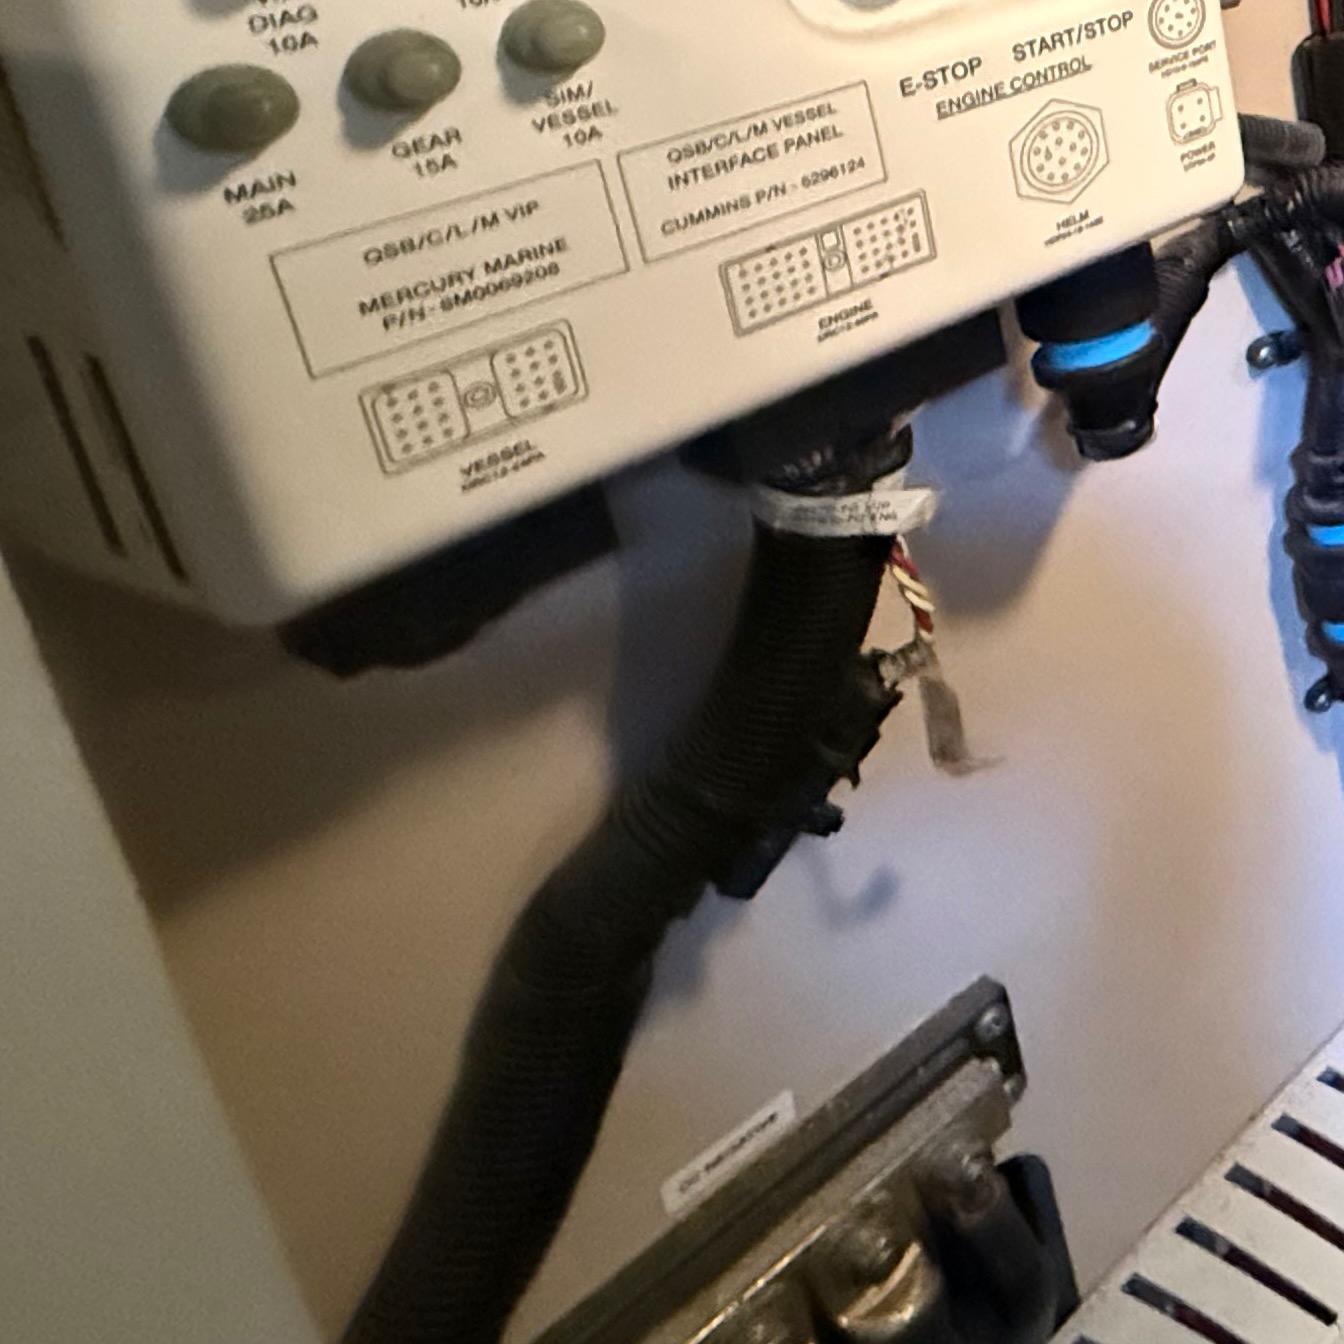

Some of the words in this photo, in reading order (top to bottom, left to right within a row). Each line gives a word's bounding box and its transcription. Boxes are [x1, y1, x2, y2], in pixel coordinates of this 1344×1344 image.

[248, 5, 318, 34] DIAG
[269, 31, 319, 56] 10A
[899, 56, 983, 98] E-STOP
[1012, 10, 1134, 62] START/STOP
[544, 80, 593, 107] SIM/
[935, 81, 1005, 118] ENGINE
[1009, 55, 1092, 95] CONTROL
[532, 100, 618, 134] VESSEL
[773, 102, 838, 132] VESSEL
[391, 126, 462, 158] GEAR
[563, 125, 603, 148] 10A
[667, 143, 779, 193] INTERFACE
[783, 124, 844, 154] PANEL
[223, 169, 297, 204] MAIN
[504, 199, 540, 222] VIP
[660, 193, 751, 236] CUMMINS
[755, 182, 787, 206] P/N
[358, 265, 475, 317] MERCURY
[484, 236, 569, 276] MARINE
[382, 304, 426, 332] P/N
